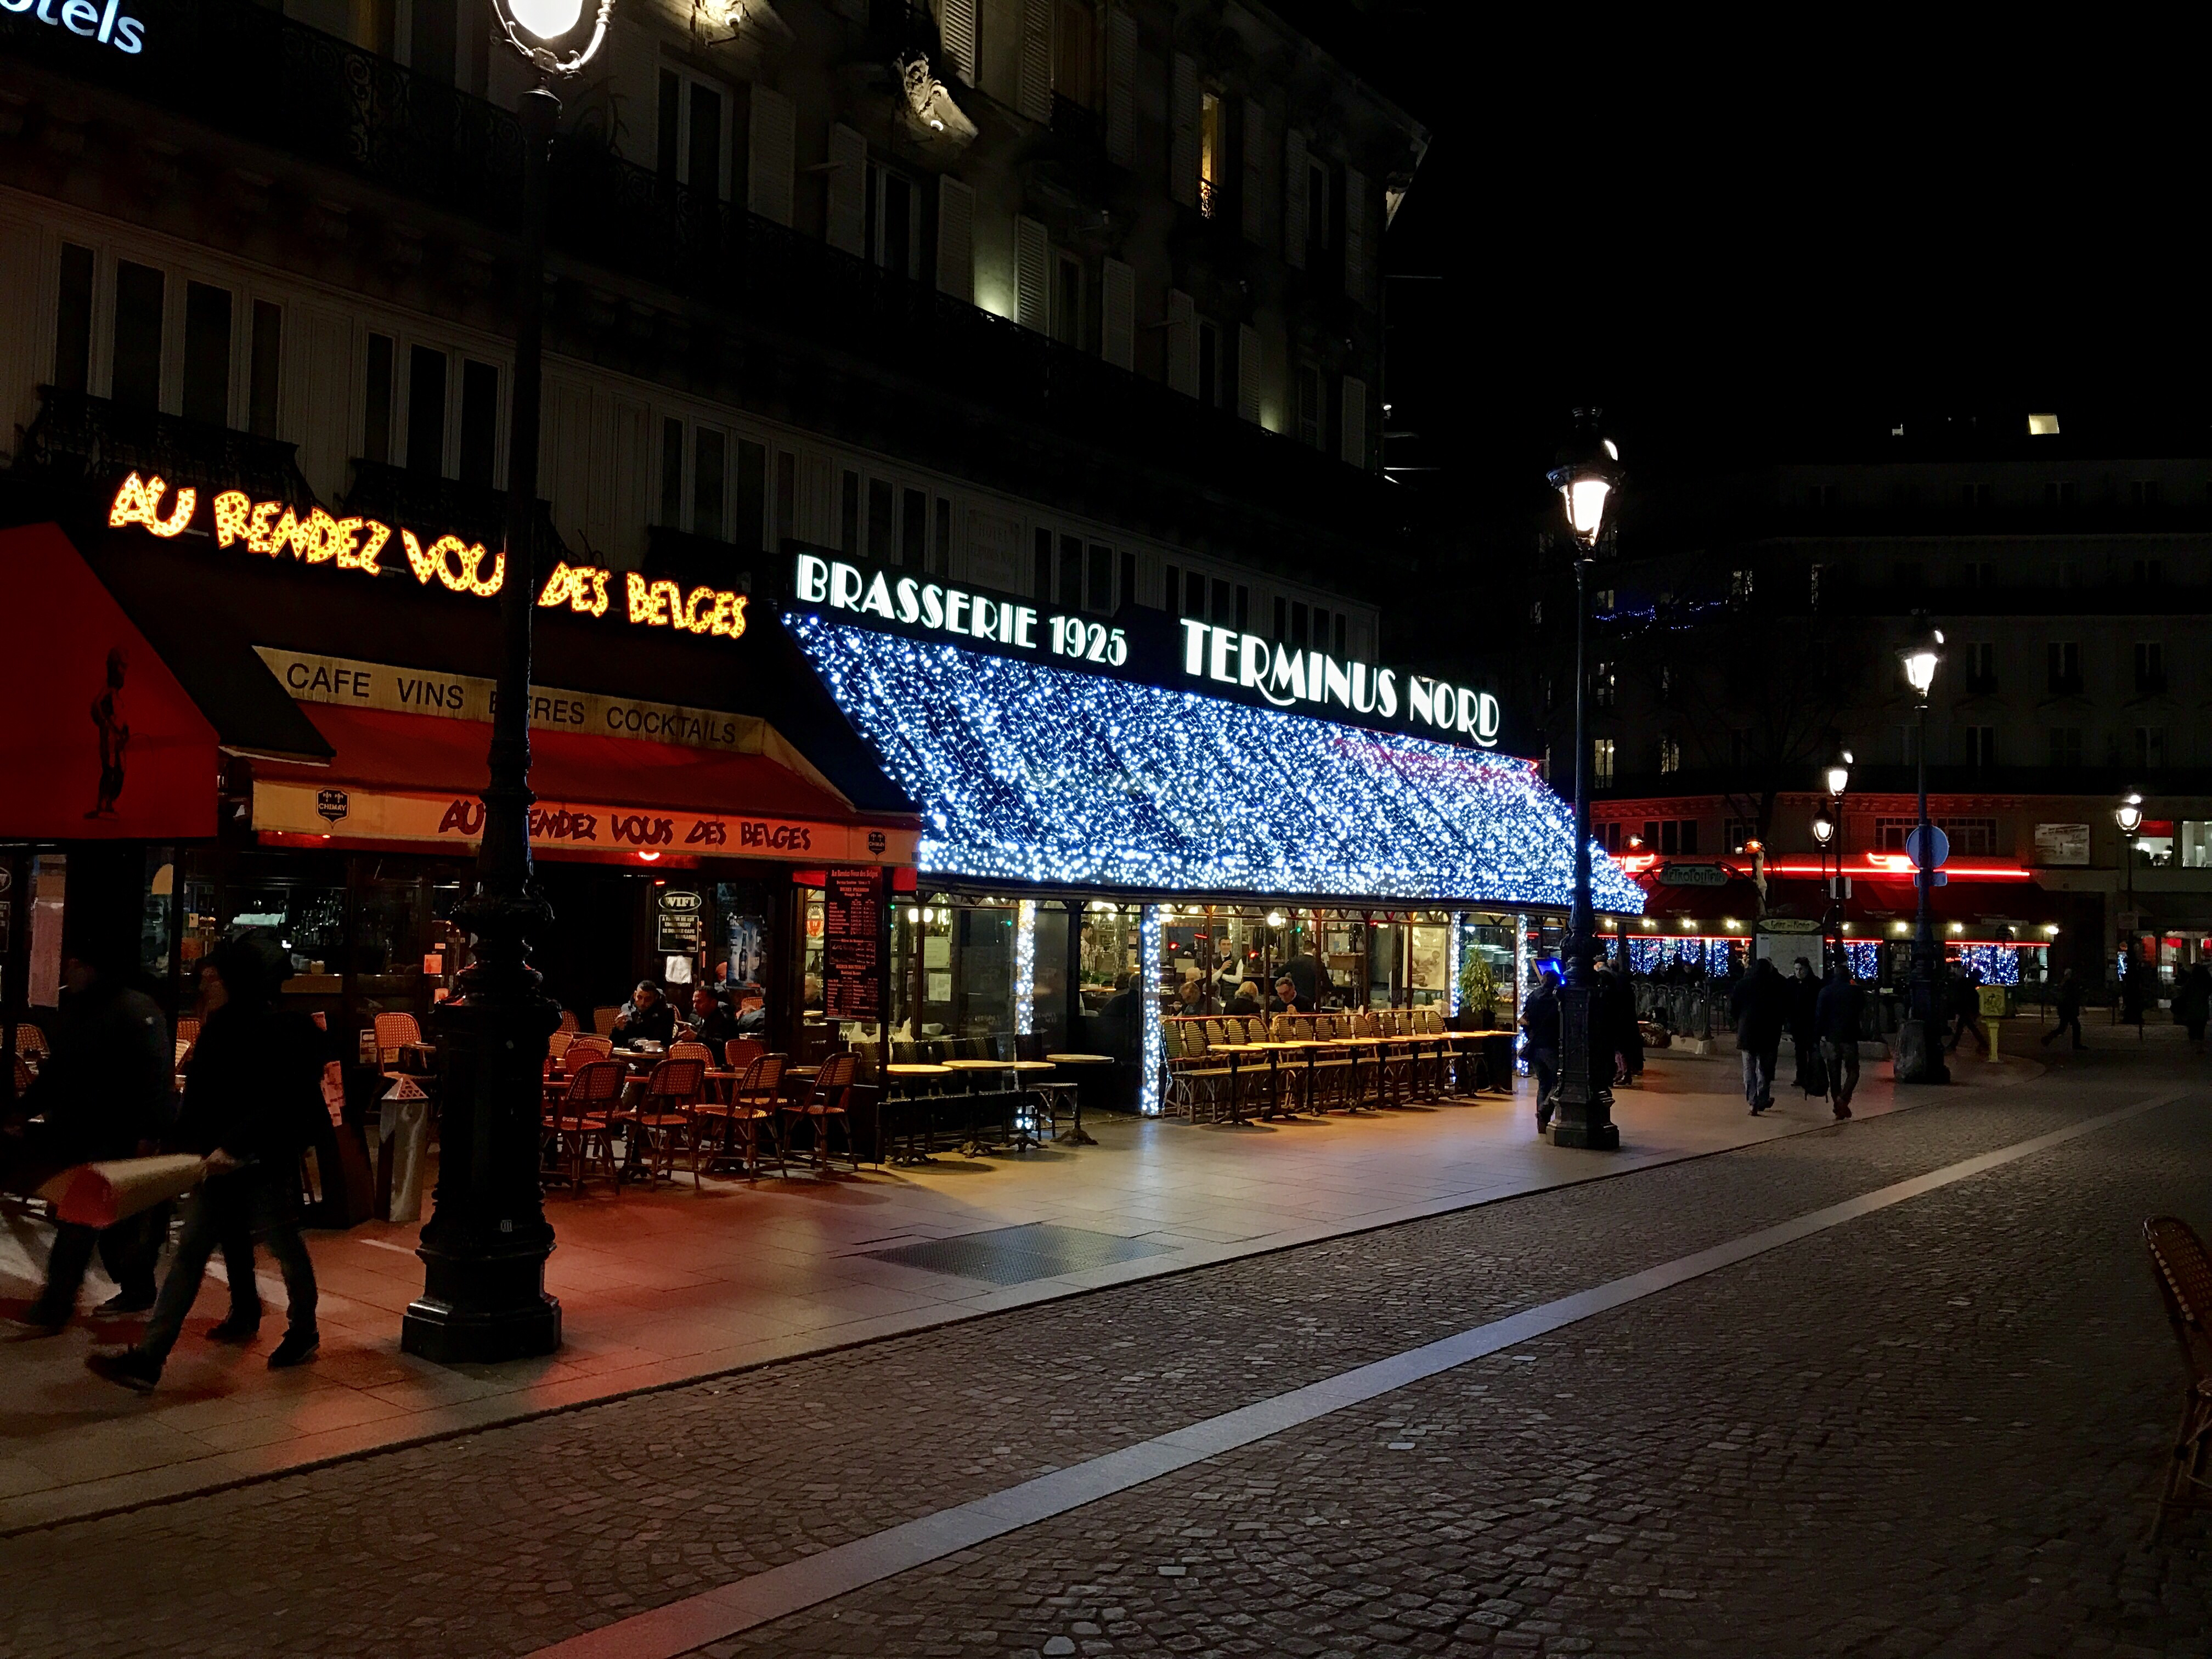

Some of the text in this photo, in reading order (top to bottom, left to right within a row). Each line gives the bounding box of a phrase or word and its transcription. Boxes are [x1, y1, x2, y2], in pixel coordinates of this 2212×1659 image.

[110, 471, 749, 639] AU RENDEZ VOU DES BELGES
[797, 554, 1128, 667] BRASSERIE 1925
[286, 663, 371, 698] CAFE
[397, 677, 464, 709] VINS
[607, 706, 736, 743] COCKTAILS
[1180, 618, 1499, 747] TERMINUS NORD
[318, 803, 347, 811] CHIMAY
[438, 799, 811, 851] AU ENDEZ VOUS DES BELGES
[665, 896, 696, 907] WIFI
